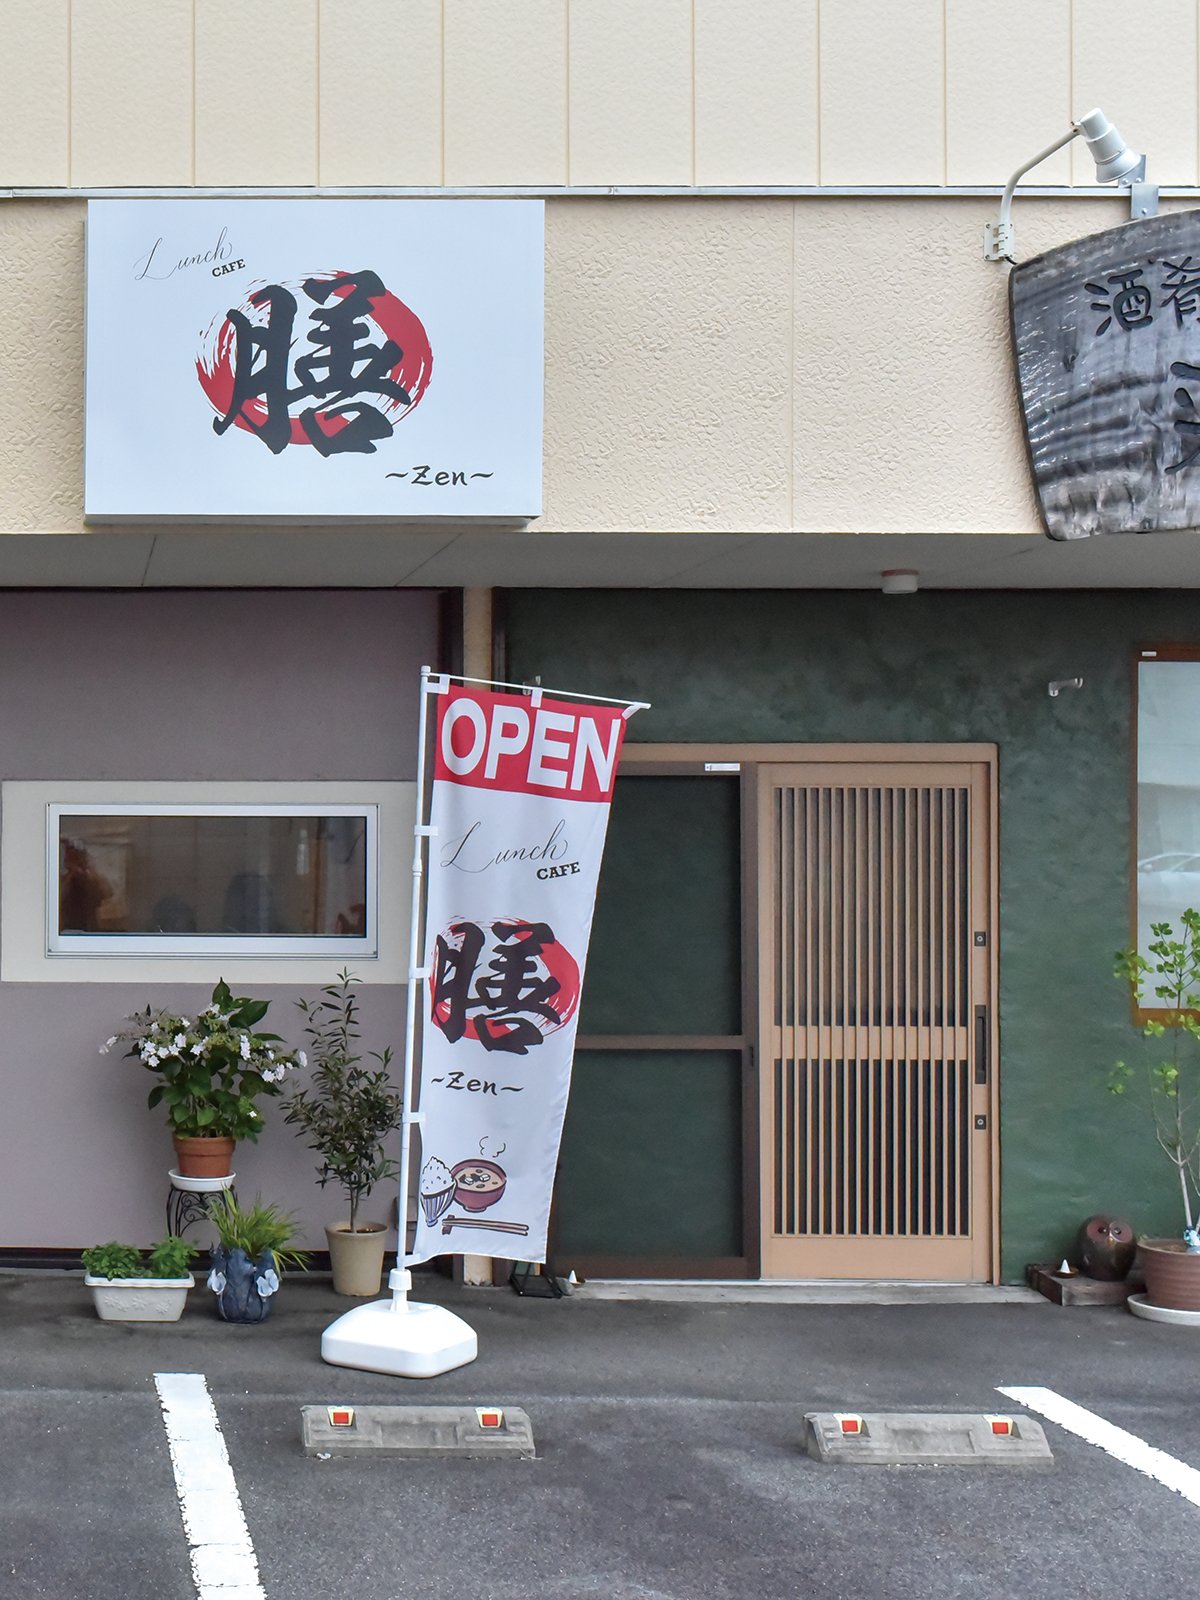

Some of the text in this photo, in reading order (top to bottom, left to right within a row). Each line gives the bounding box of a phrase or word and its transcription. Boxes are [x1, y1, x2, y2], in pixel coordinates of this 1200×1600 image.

[133, 226, 233, 280] Lunch
[211, 258, 246, 278] CAFE
[212, 269, 411, 457] 膳
[441, 697, 622, 792] OPEN
[440, 819, 569, 874] Lunch
[536, 862, 581, 881] CAFE
[430, 921, 562, 1056] 膳
